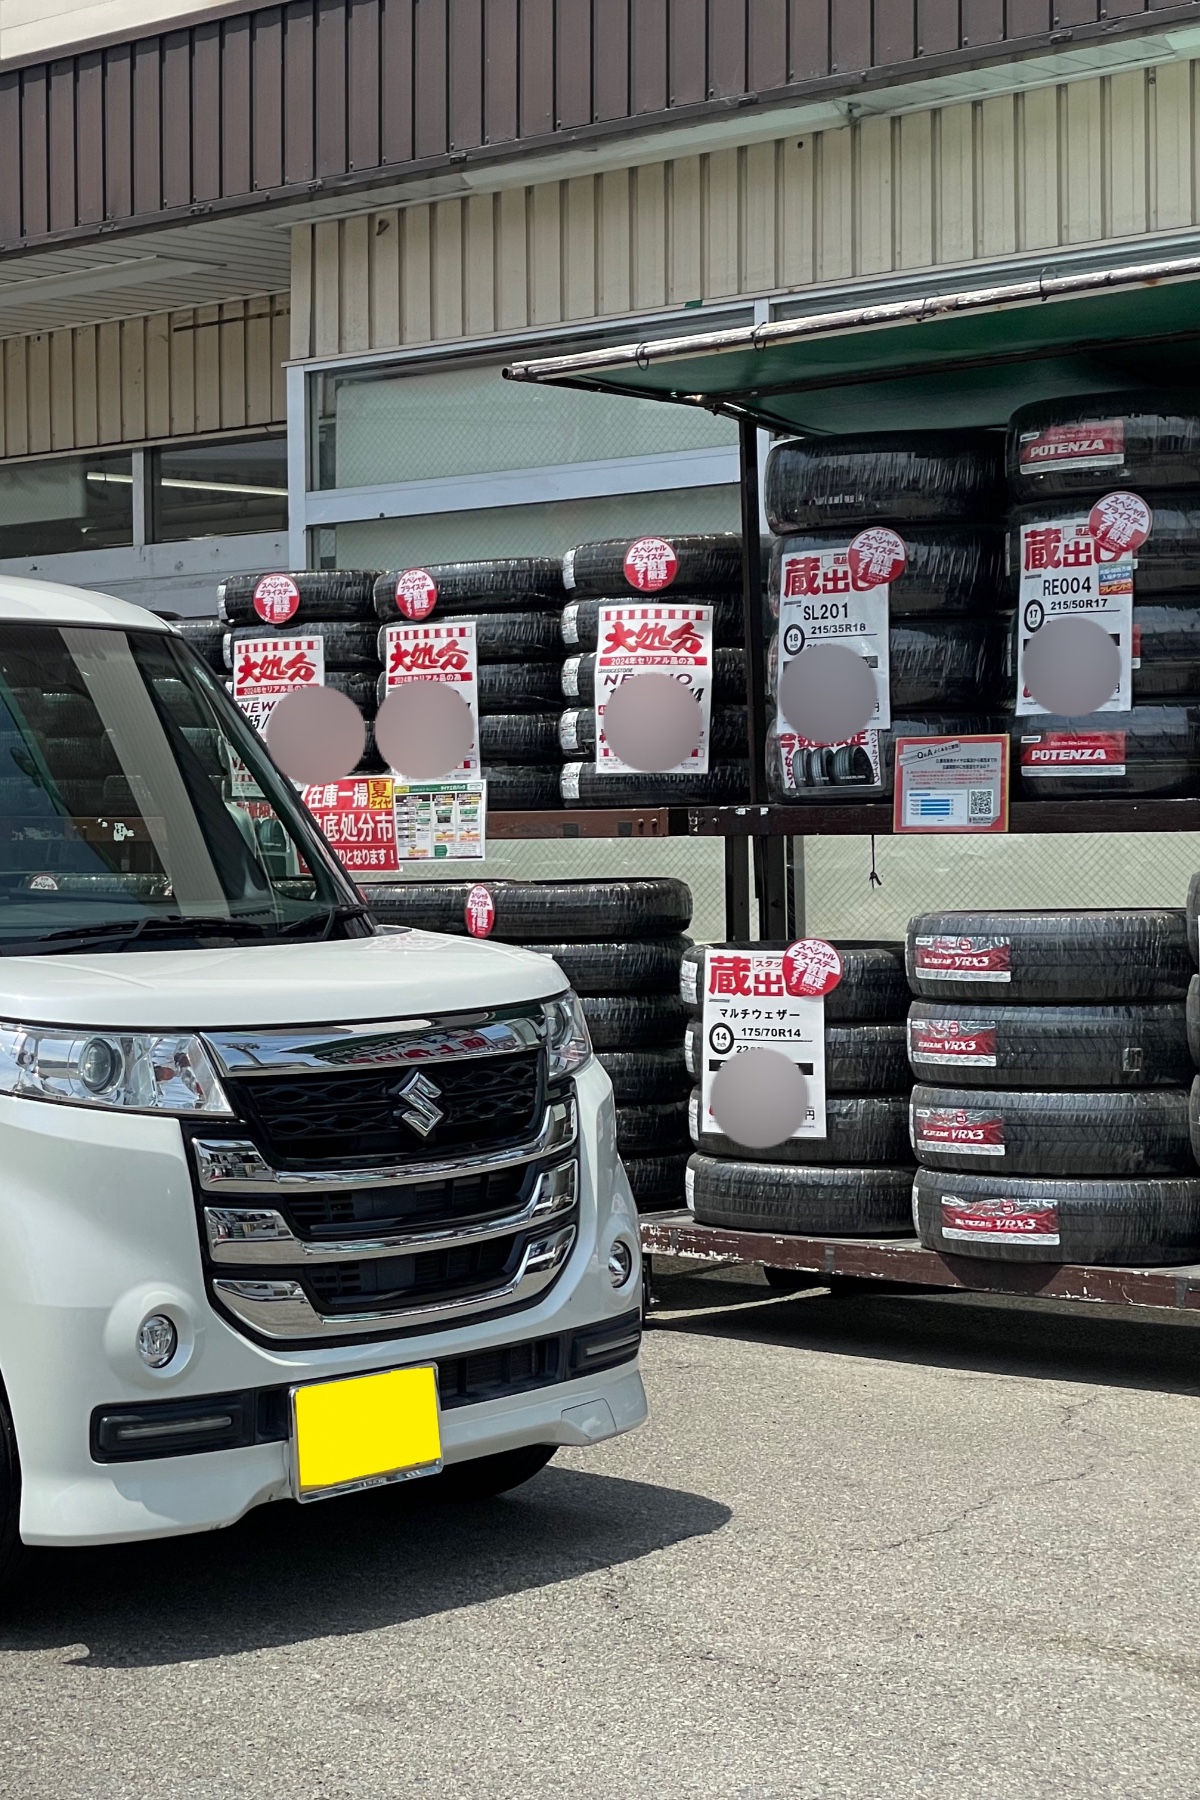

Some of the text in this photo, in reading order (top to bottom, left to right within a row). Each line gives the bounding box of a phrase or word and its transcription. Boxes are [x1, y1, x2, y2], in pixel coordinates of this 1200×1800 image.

[1030, 439, 1104, 457] POTENZA
[1110, 496, 1146, 518] スペシャル
[863, 533, 900, 548] スペシャル
[633, 545, 667, 554] スペシャル
[1043, 577, 1091, 596] RE004
[1051, 599, 1108, 610] 215/50R17
[803, 603, 848, 620] SL201
[1029, 610, 1038, 618] 17
[811, 623, 866, 634] 215/35R18
[602, 621, 703, 654] 大処分
[789, 633, 798, 641] 18
[389, 639, 469, 673] 大処分
[610, 656, 695, 666] 2024年セリアル品の為
[237, 652, 316, 684] 大処分
[604, 673, 693, 685] NEO
[917, 748, 933, 760] Q&A
[1031, 749, 1106, 760] POTENZA
[307, 780, 391, 808] 在庫一掃 夏
[371, 800, 392, 808] タイヤ
[334, 848, 395, 865] りとなります！
[799, 942, 836, 961] スペシャル
[954, 957, 989, 966] VRX3
[720, 1009, 800, 1020] マルチウェザー
[741, 1027, 801, 1038] 175/70R14
[944, 1041, 977, 1050] VRX3
[951, 1130, 984, 1139] VRX3
[995, 1218, 1036, 1229] VRX3
